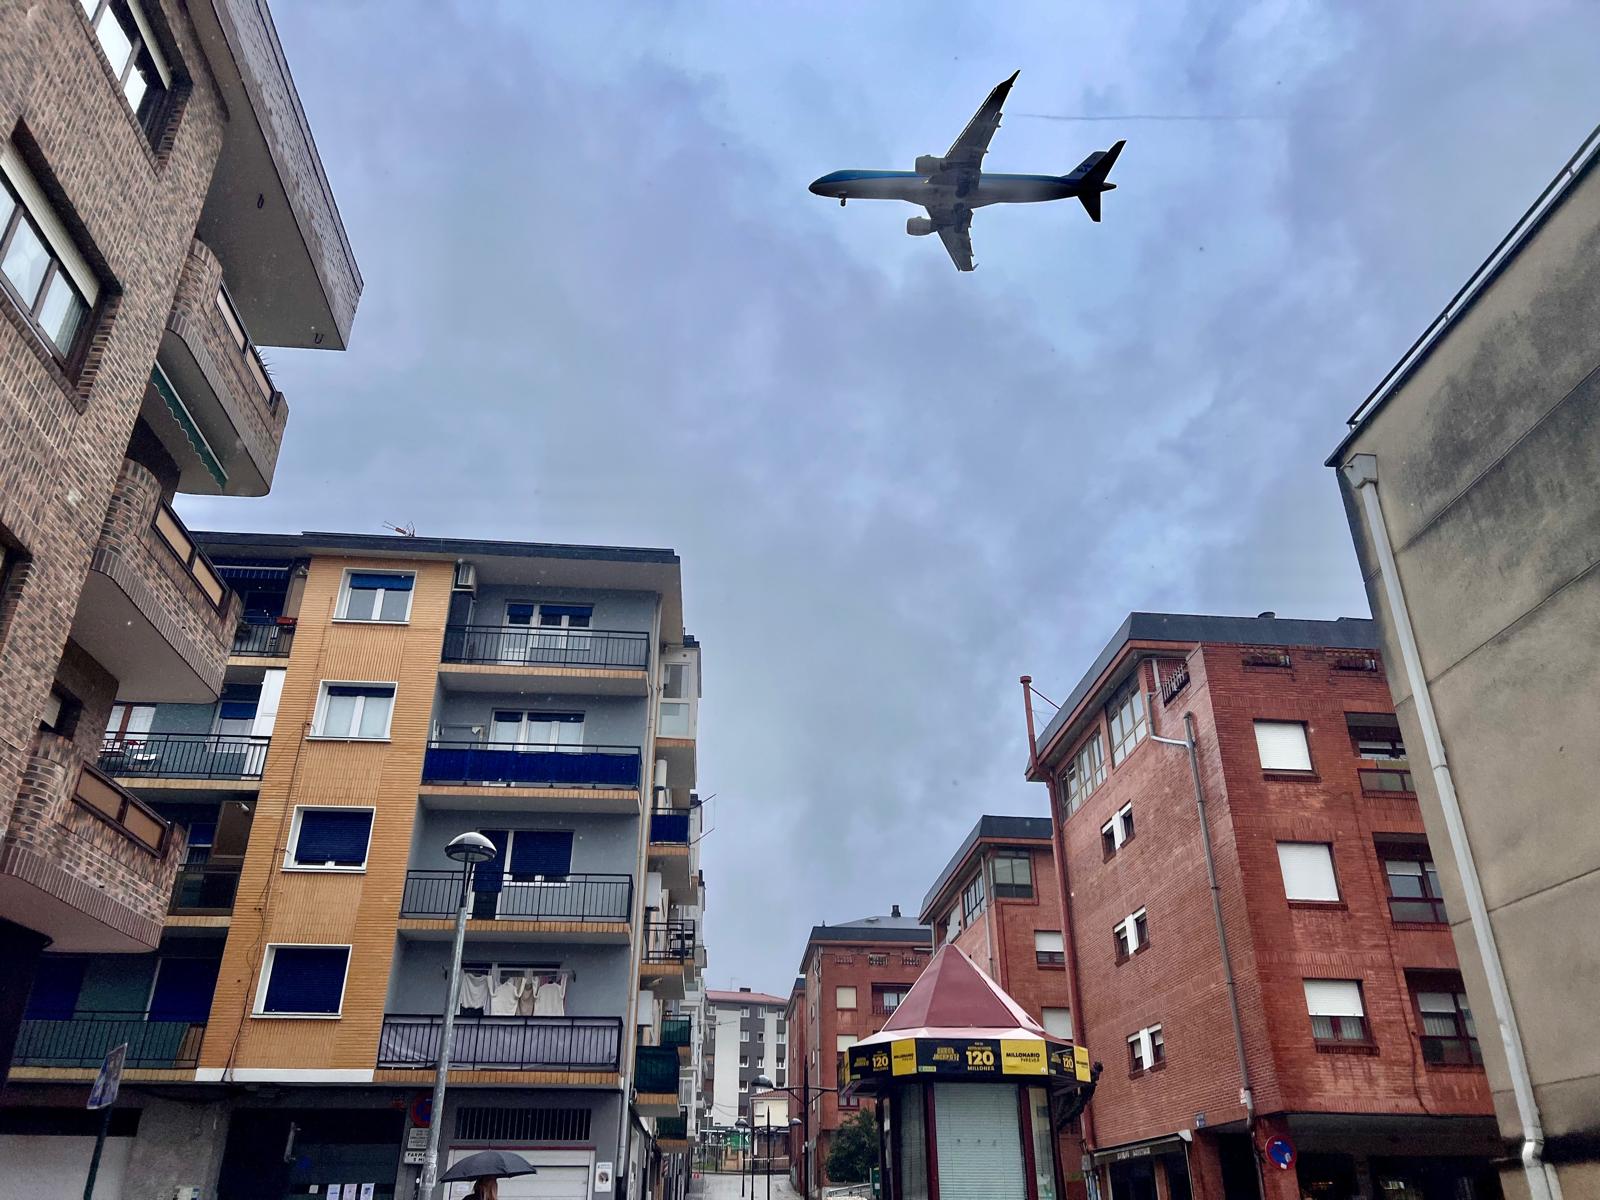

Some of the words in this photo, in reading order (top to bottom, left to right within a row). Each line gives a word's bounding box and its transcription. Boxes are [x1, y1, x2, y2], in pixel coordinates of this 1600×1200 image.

[872, 1056, 889, 1068] 120
[965, 1051, 995, 1066] 120
[1062, 1057, 1074, 1069] 120
